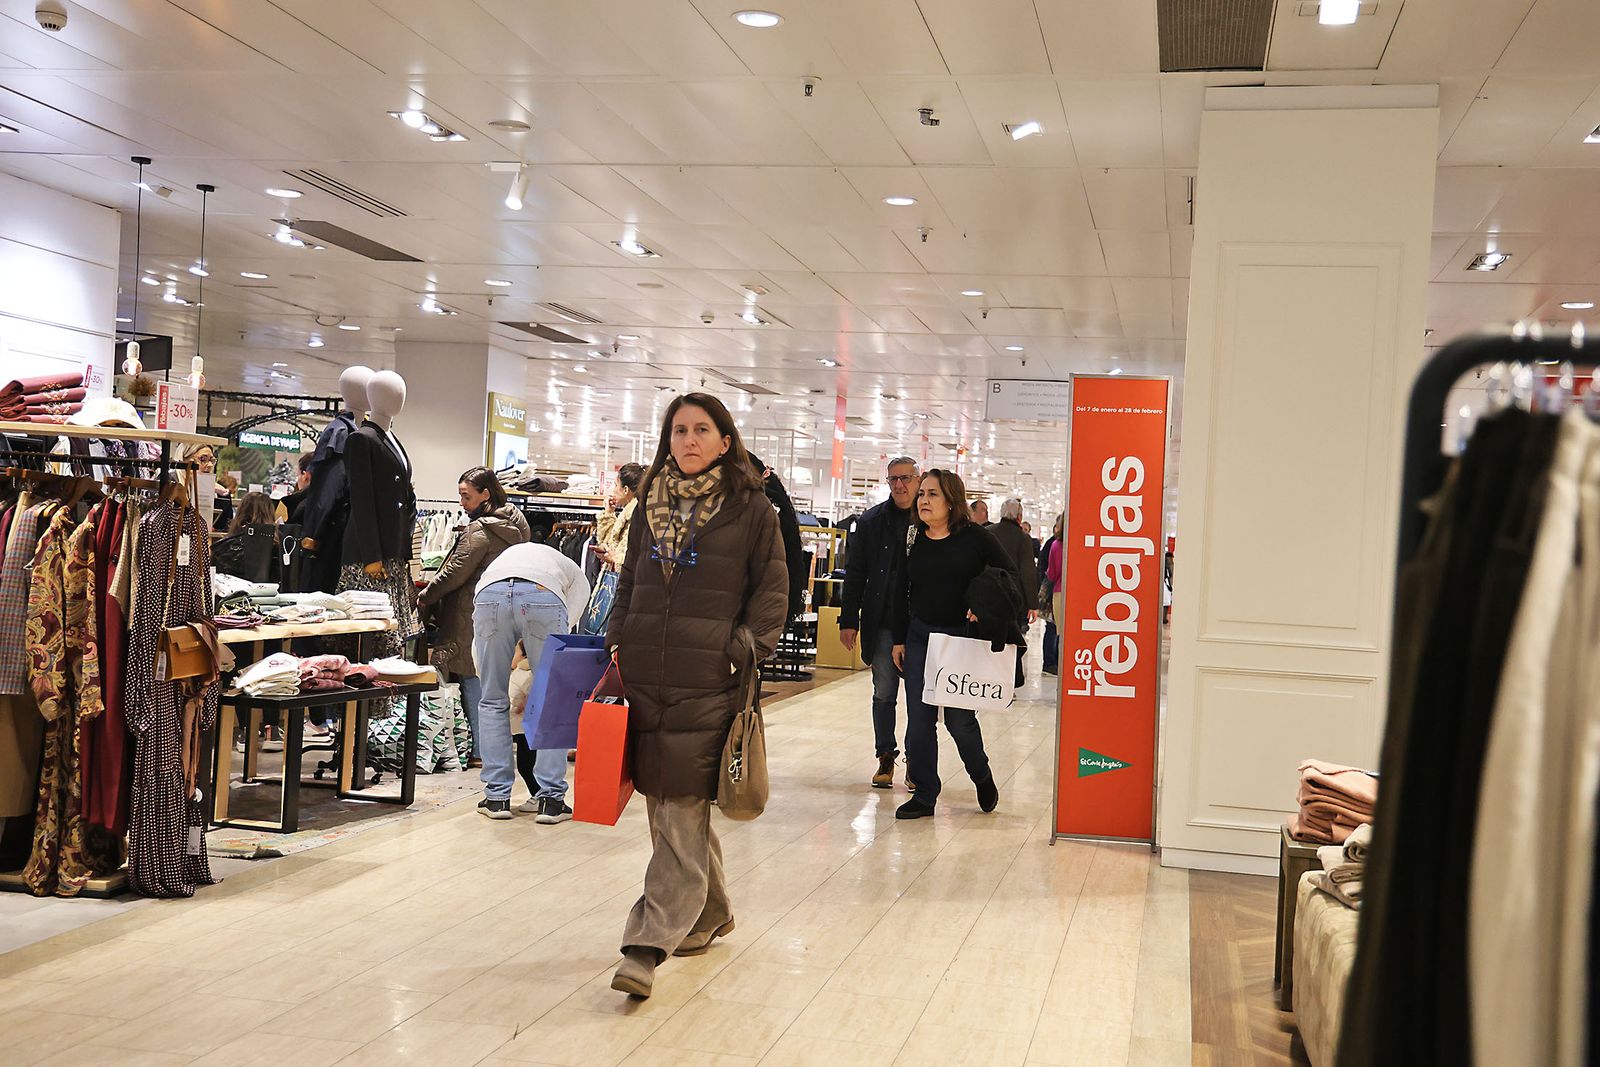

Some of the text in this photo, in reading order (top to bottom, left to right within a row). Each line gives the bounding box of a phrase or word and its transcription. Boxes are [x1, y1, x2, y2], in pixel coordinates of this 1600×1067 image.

[993, 383, 1001, 393] B
[170, 404, 193, 418] -30%
[1082, 456, 1154, 698] rebajas
[1068, 648, 1092, 696] Las
[946, 673, 1003, 700] Sfera
